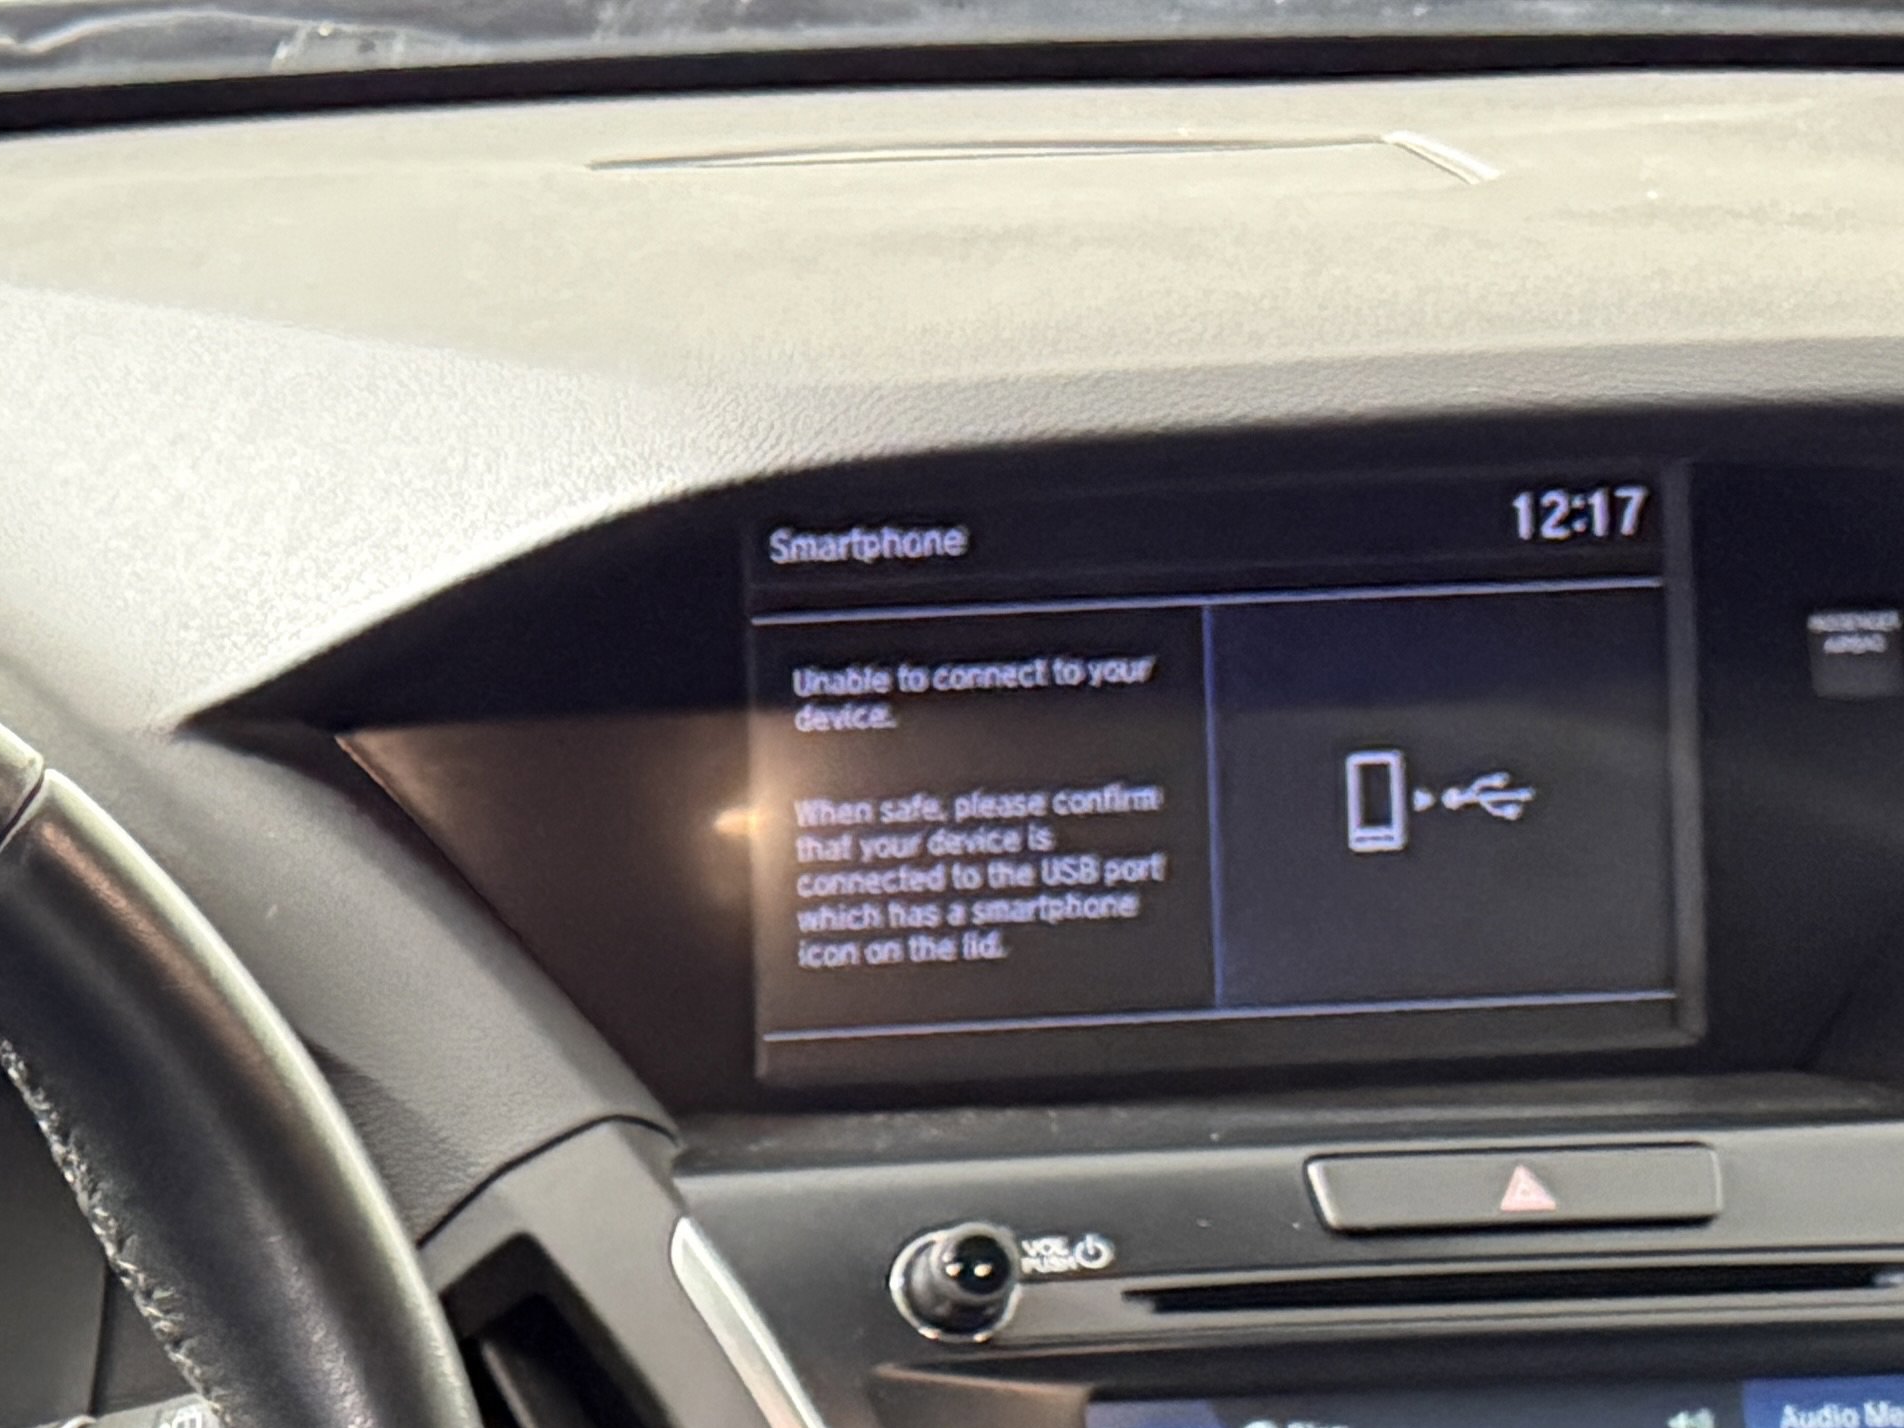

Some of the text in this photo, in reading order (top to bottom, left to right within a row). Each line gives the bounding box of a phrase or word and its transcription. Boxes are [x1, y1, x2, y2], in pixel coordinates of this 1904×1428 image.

[1512, 485, 1649, 541] 12:17
[769, 525, 971, 564] Smartphone
[792, 655, 1158, 698] Unable to connect to your
[794, 702, 899, 732] device.
[795, 795, 873, 828] When
[953, 787, 1048, 823] please
[1052, 782, 1164, 816] confirm
[796, 821, 1055, 864] that your device is
[797, 852, 1169, 898] connected to the USB port
[797, 890, 1141, 933] which has a smartphone
[798, 929, 1009, 969] icon on the lid.
